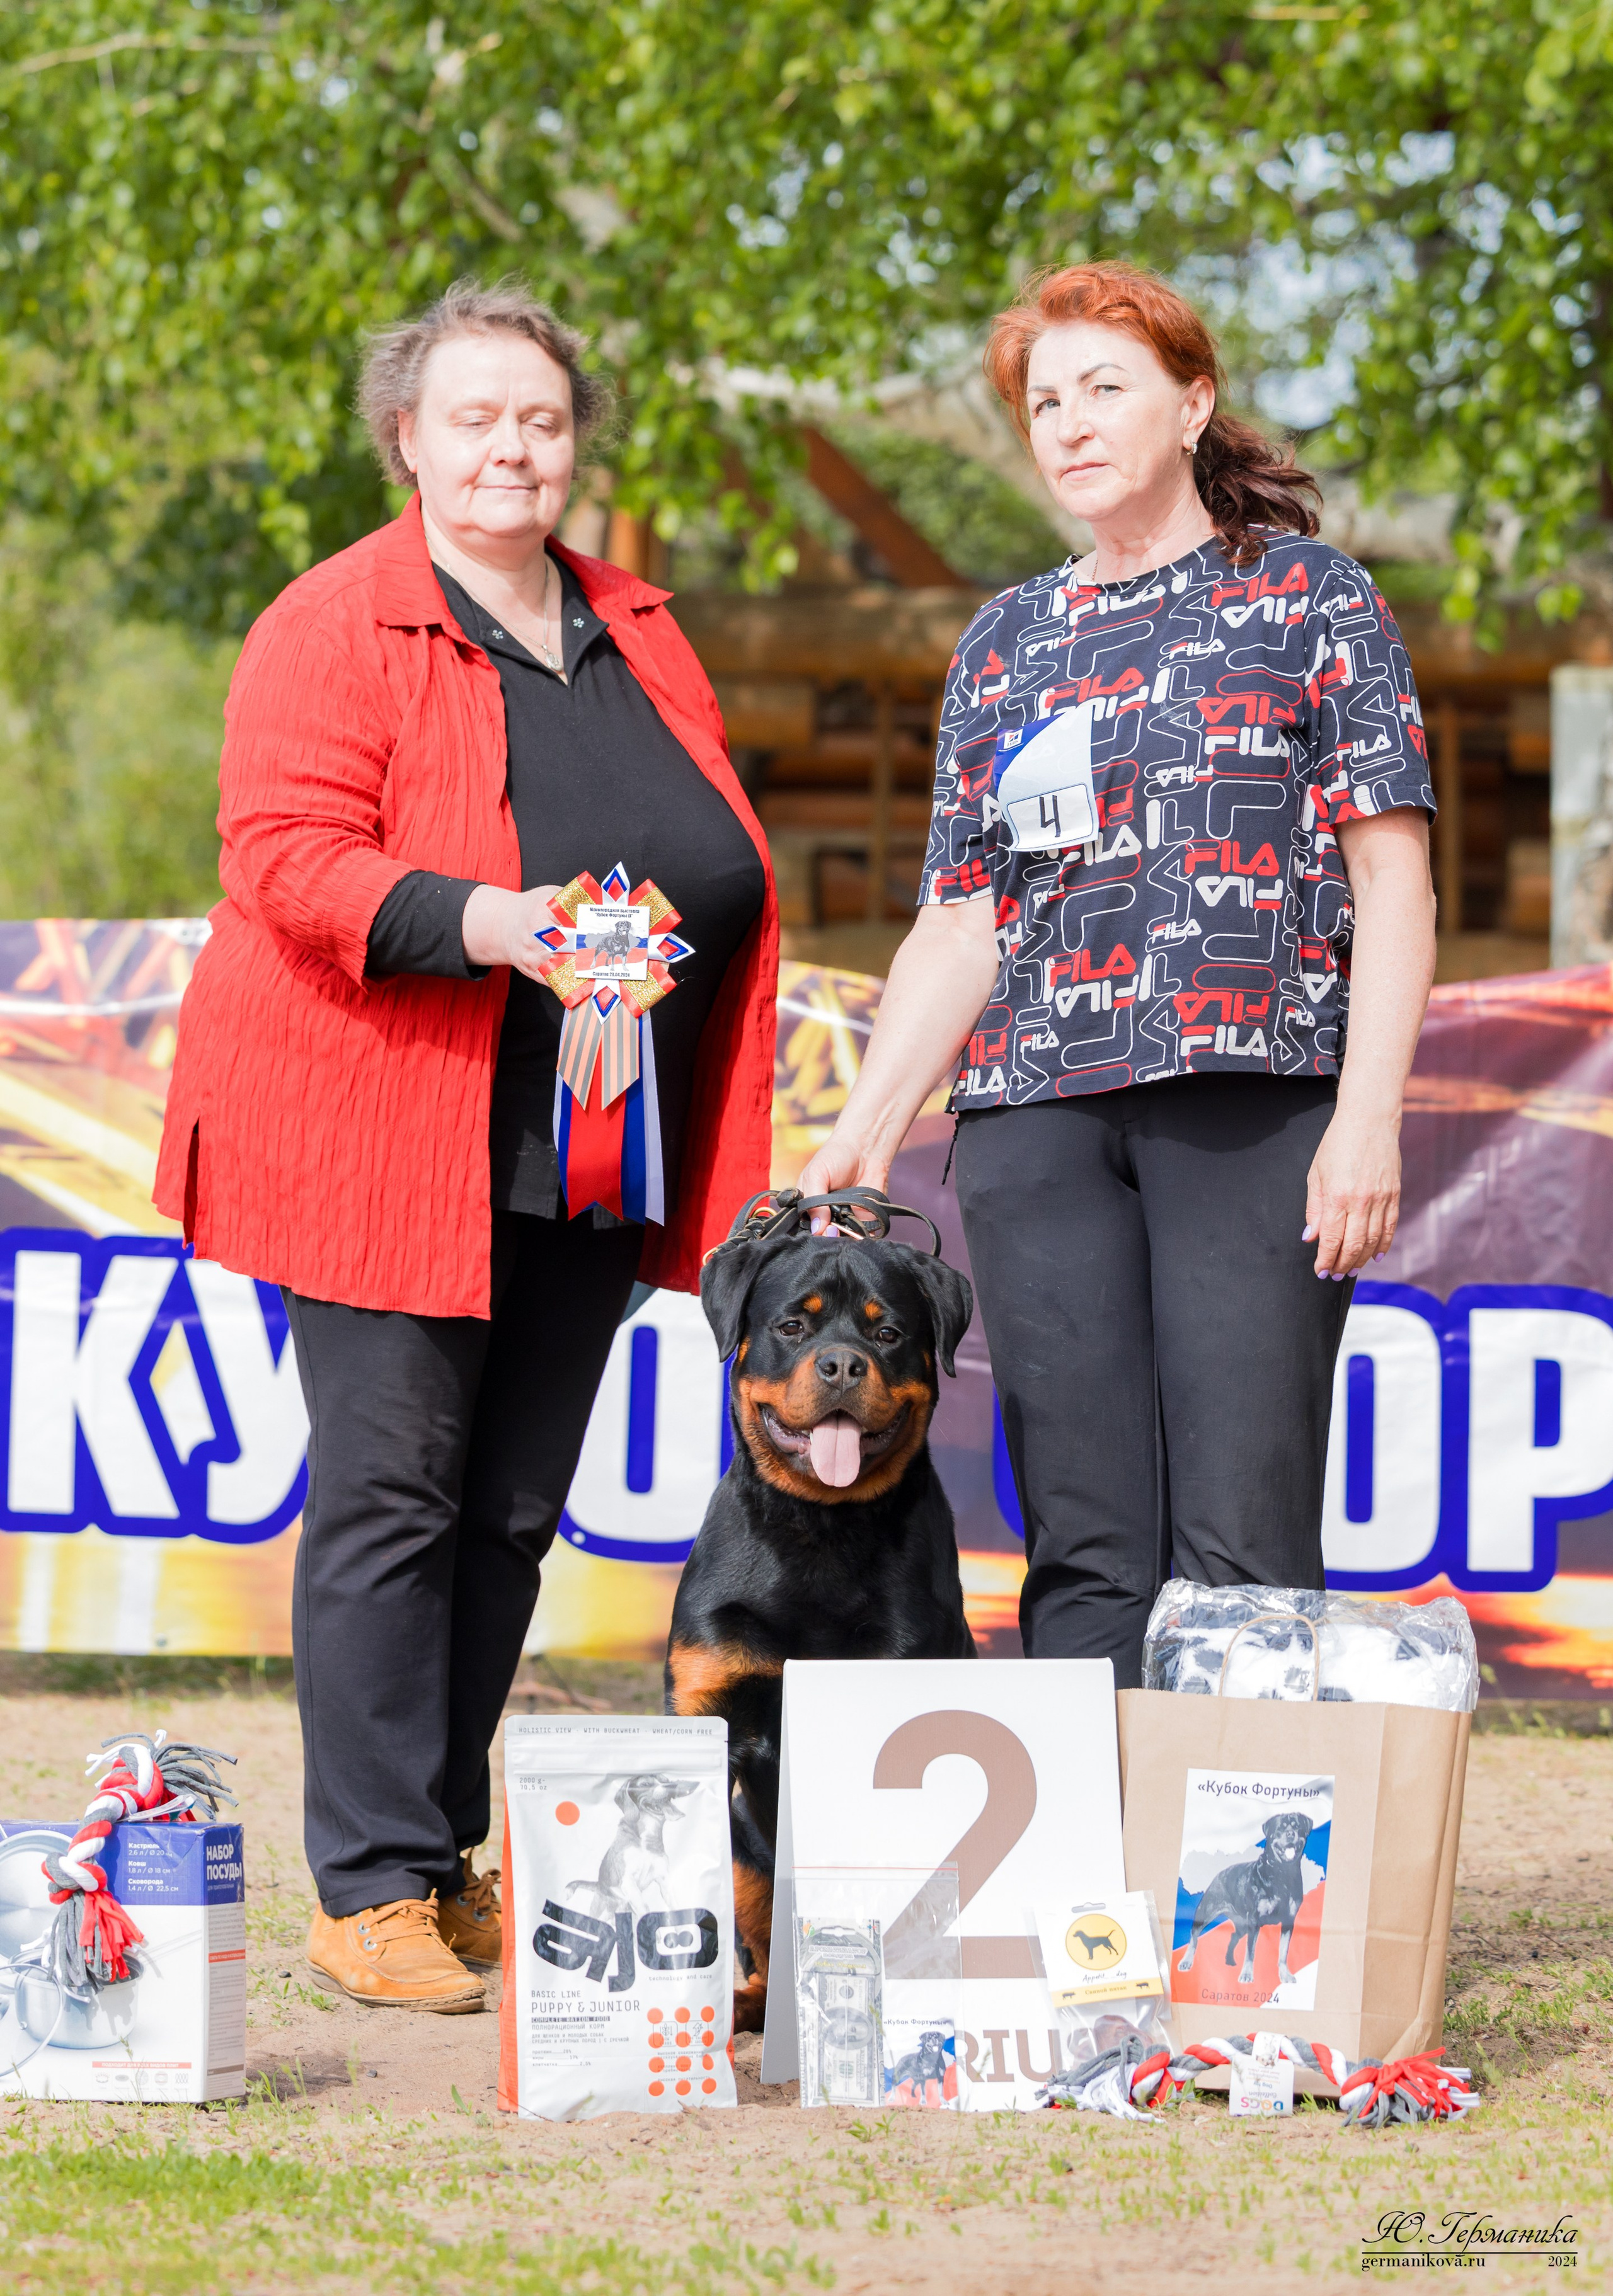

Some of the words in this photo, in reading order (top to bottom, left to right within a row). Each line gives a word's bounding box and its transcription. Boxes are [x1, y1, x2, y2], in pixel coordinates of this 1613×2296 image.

[1212, 563, 1309, 607] FILA
[1025, 632, 1076, 656] FILA
[1169, 638, 1226, 660] FILA
[1045, 668, 1144, 708] FILA
[1205, 726, 1290, 758] FILA
[1336, 734, 1392, 761] FILA
[1156, 764, 1213, 787] FILA
[1040, 794, 1061, 837] 4
[1185, 840, 1279, 876] FILA
[934, 859, 990, 897] FIL
[1195, 876, 1283, 910] FILA
[1152, 919, 1202, 943] FILA
[1049, 943, 1136, 987] FILA
[1055, 974, 1140, 1018] FILA
[1173, 991, 1270, 1026] FILA
[1020, 1031, 1059, 1053] FILA
[1181, 1024, 1268, 1058] FILA
[1198, 1780, 1247, 1796] «Кубок
[1252, 1783, 1320, 1800] Фортуны»
[206, 1844, 234, 1861] НАБОР
[873, 1709, 1047, 1979] 2
[207, 1862, 242, 1881] ПОСУДЫ
[531, 1990, 556, 1998] BASIC
[532, 2002, 572, 2013] PUPPY
[578, 2002, 585, 2013] &
[590, 2001, 641, 2013] JUNIOR
[1202, 1989, 1249, 2002] Саратов
[1254, 1992, 1279, 2003] 2024
[1241, 2096, 1283, 2111] DOGS
